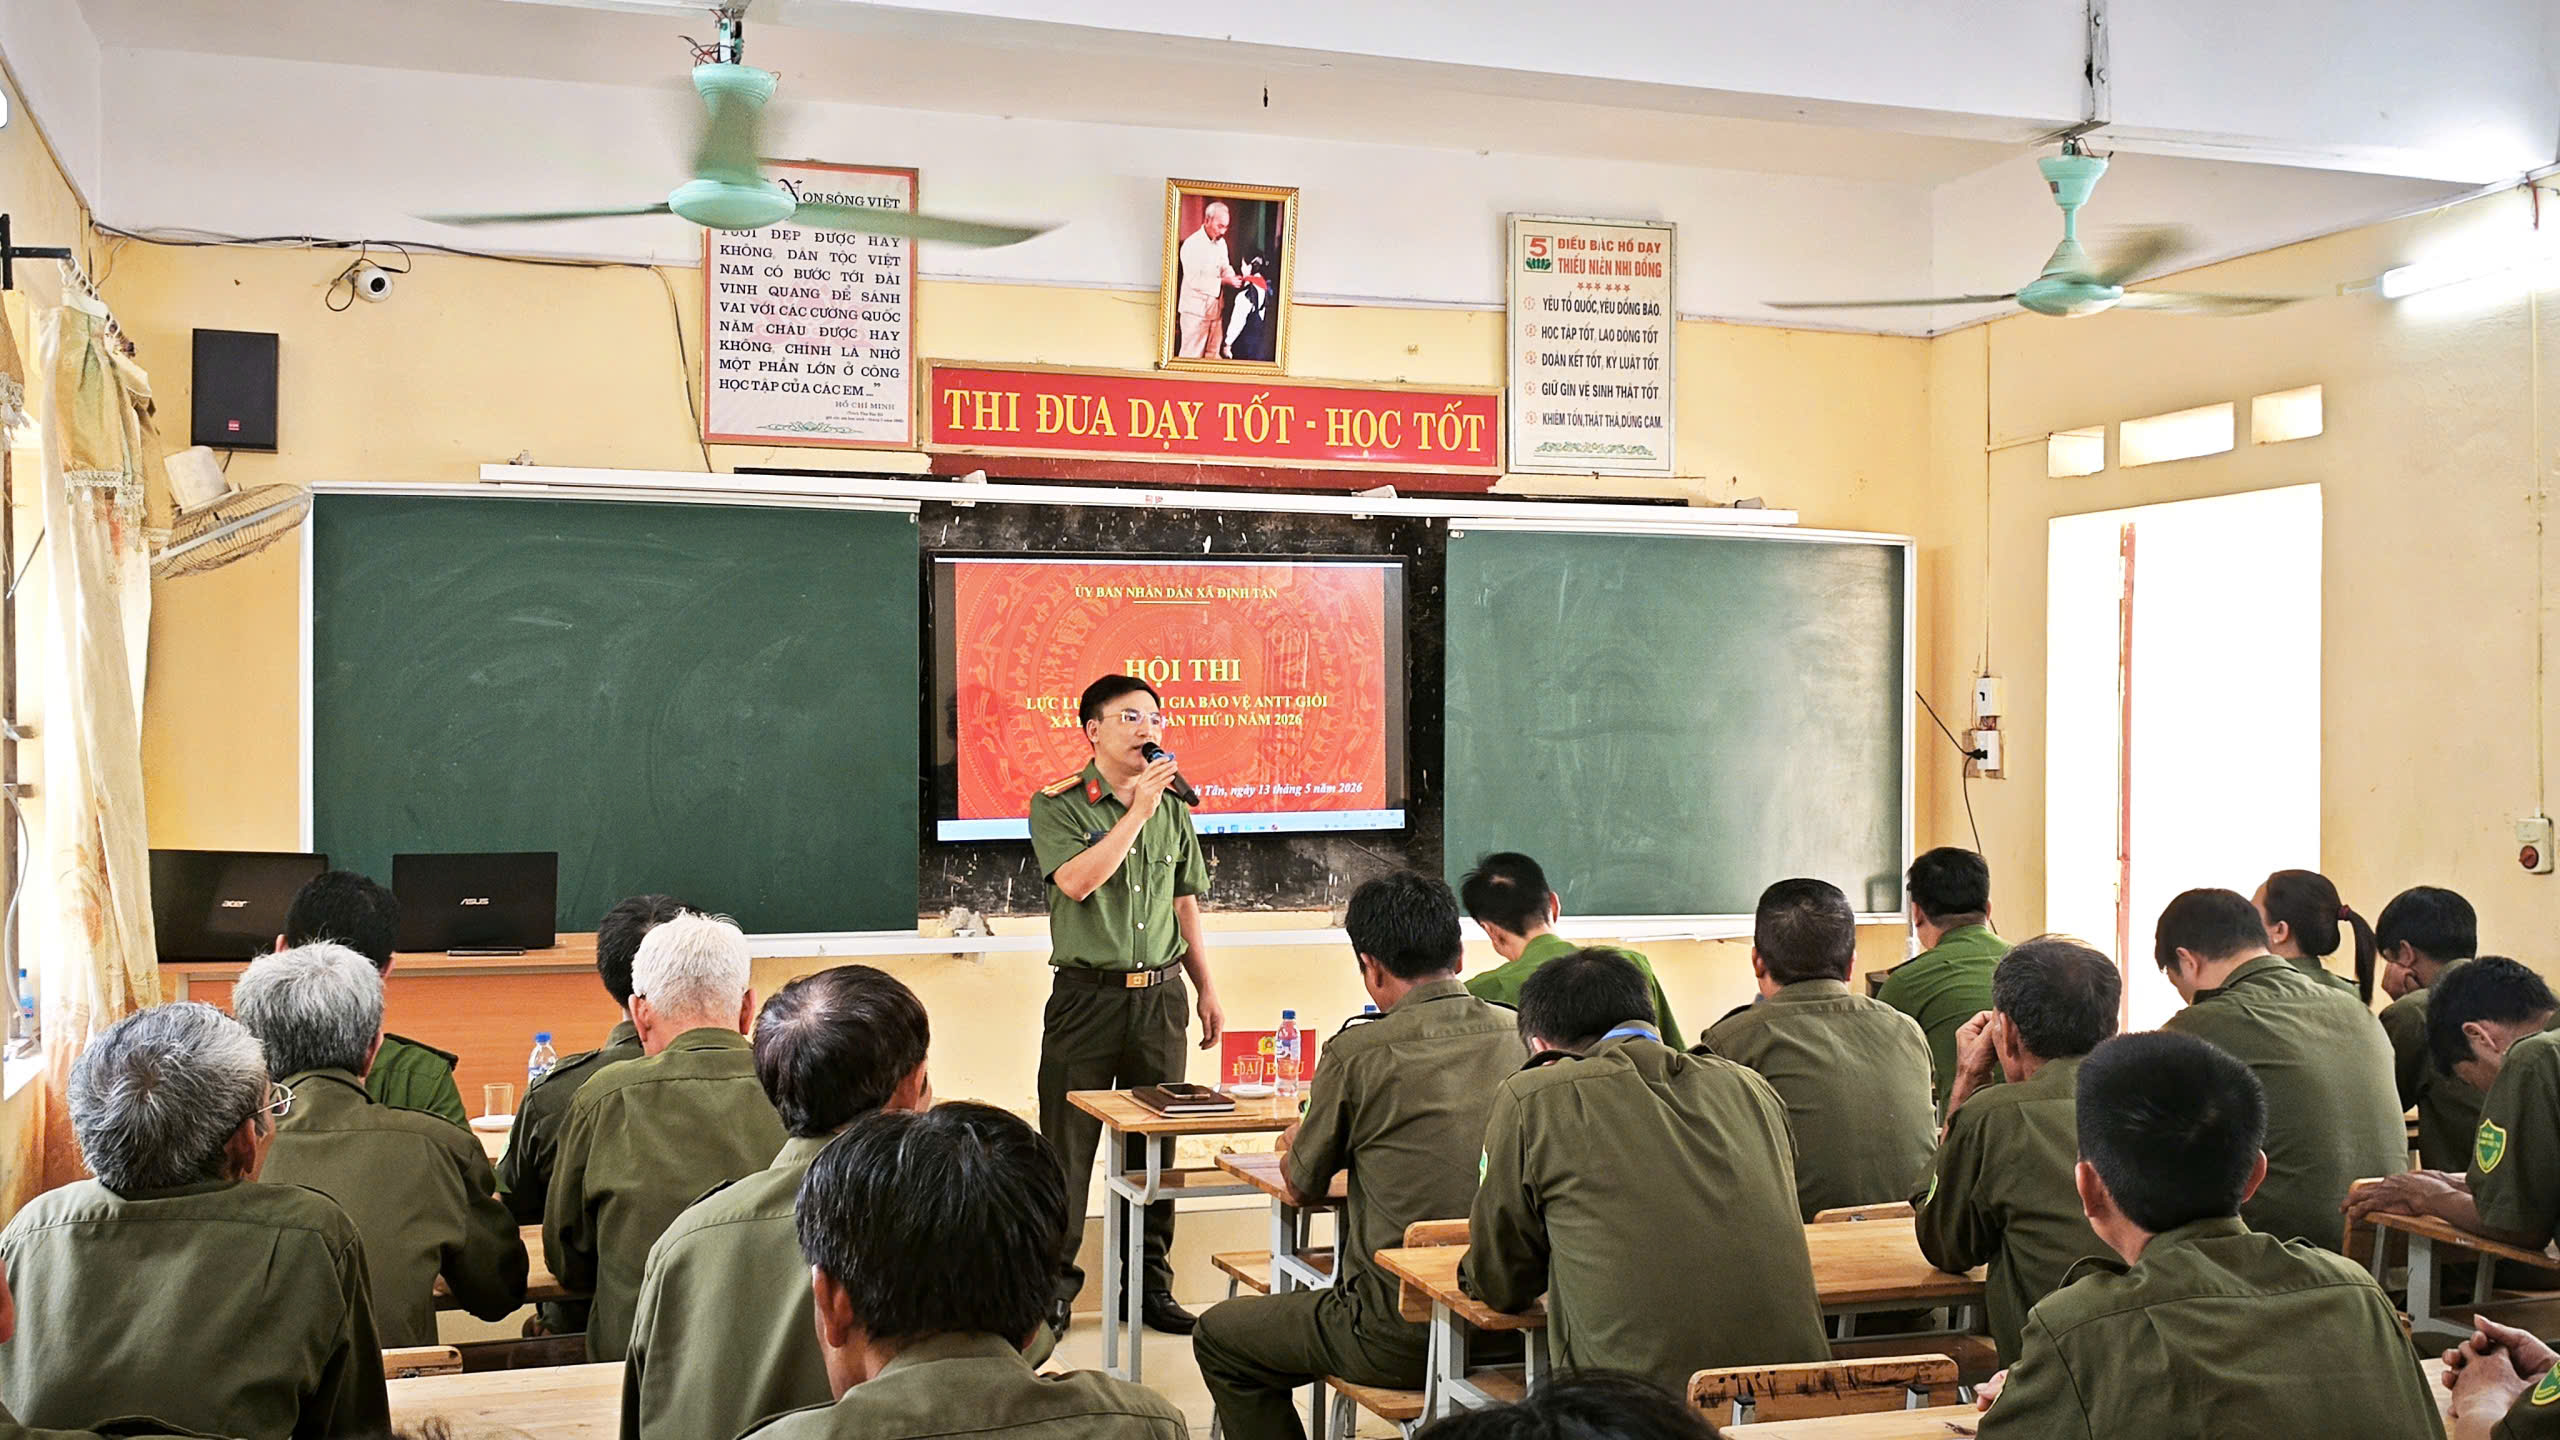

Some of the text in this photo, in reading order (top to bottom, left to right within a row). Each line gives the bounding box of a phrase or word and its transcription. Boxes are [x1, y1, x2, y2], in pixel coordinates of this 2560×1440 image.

[826, 192, 865, 207] SÔNG
[771, 229, 801, 243] ĐẸP
[814, 232, 856, 247] ĐƯỢC
[868, 236, 901, 248] HAY
[1529, 238, 1547, 257] 5
[787, 248, 819, 261] DÂN
[829, 250, 857, 265] TỘC
[868, 252, 901, 269] VIỆT
[1615, 260, 1632, 276] NHI
[720, 264, 901, 285] NAM CÓ BƯỚC TỚI ĐÀI
[720, 283, 901, 304] VINH QUANG ĐỂ SÁNH
[720, 302, 901, 323] VAI VỚI CÁC CƯỜNG QUỐC
[720, 319, 901, 341] NĂM CHÂU ĐƯỢC HAY
[1599, 329, 1615, 342] LAO
[785, 342, 831, 356] CHÍNH
[841, 344, 860, 358] LÀ
[869, 347, 901, 360] NHỜ
[719, 357, 901, 379] MỘT PHẦN LỚN Ở CÔNG
[719, 379, 749, 392] HỌC
[751, 379, 780, 394] TẬP
[781, 378, 810, 393] CỦA
[813, 381, 841, 395] CÁC
[1592, 384, 1613, 398] SINH
[944, 389, 1021, 432] THI
[1036, 394, 1117, 436] ĐUA
[1128, 398, 1204, 450] DẠY
[1218, 392, 1295, 444] TỐT
[1325, 408, 1402, 457] HỌC
[1413, 400, 1485, 452] TỐT
[1096, 586, 1122, 598] BAN
[1126, 584, 1165, 598] NHÂN
[1166, 584, 1193, 599] DÂN
[1196, 585, 1215, 599] XÃ
[1217, 587, 1250, 602] ĐỊNH
[1252, 584, 1278, 599] TÂN
[1124, 655, 1241, 688] HỘI THI
[1026, 695, 1059, 713] LỰC
[1169, 696, 1195, 709] GIA
[1232, 694, 1252, 710] VỆ
[1254, 695, 1293, 708] ANTT
[1295, 692, 1328, 708] GIỎI
[1050, 713, 1073, 728] XÃ
[1189, 712, 1221, 726] THỨ
[1238, 712, 1271, 726] NĂM
[1274, 714, 1303, 726] 2026
[1258, 784, 1270, 795] 13
[1305, 783, 1311, 793] 5
[1338, 782, 1363, 793] 2026
[222, 900, 249, 908] acer
